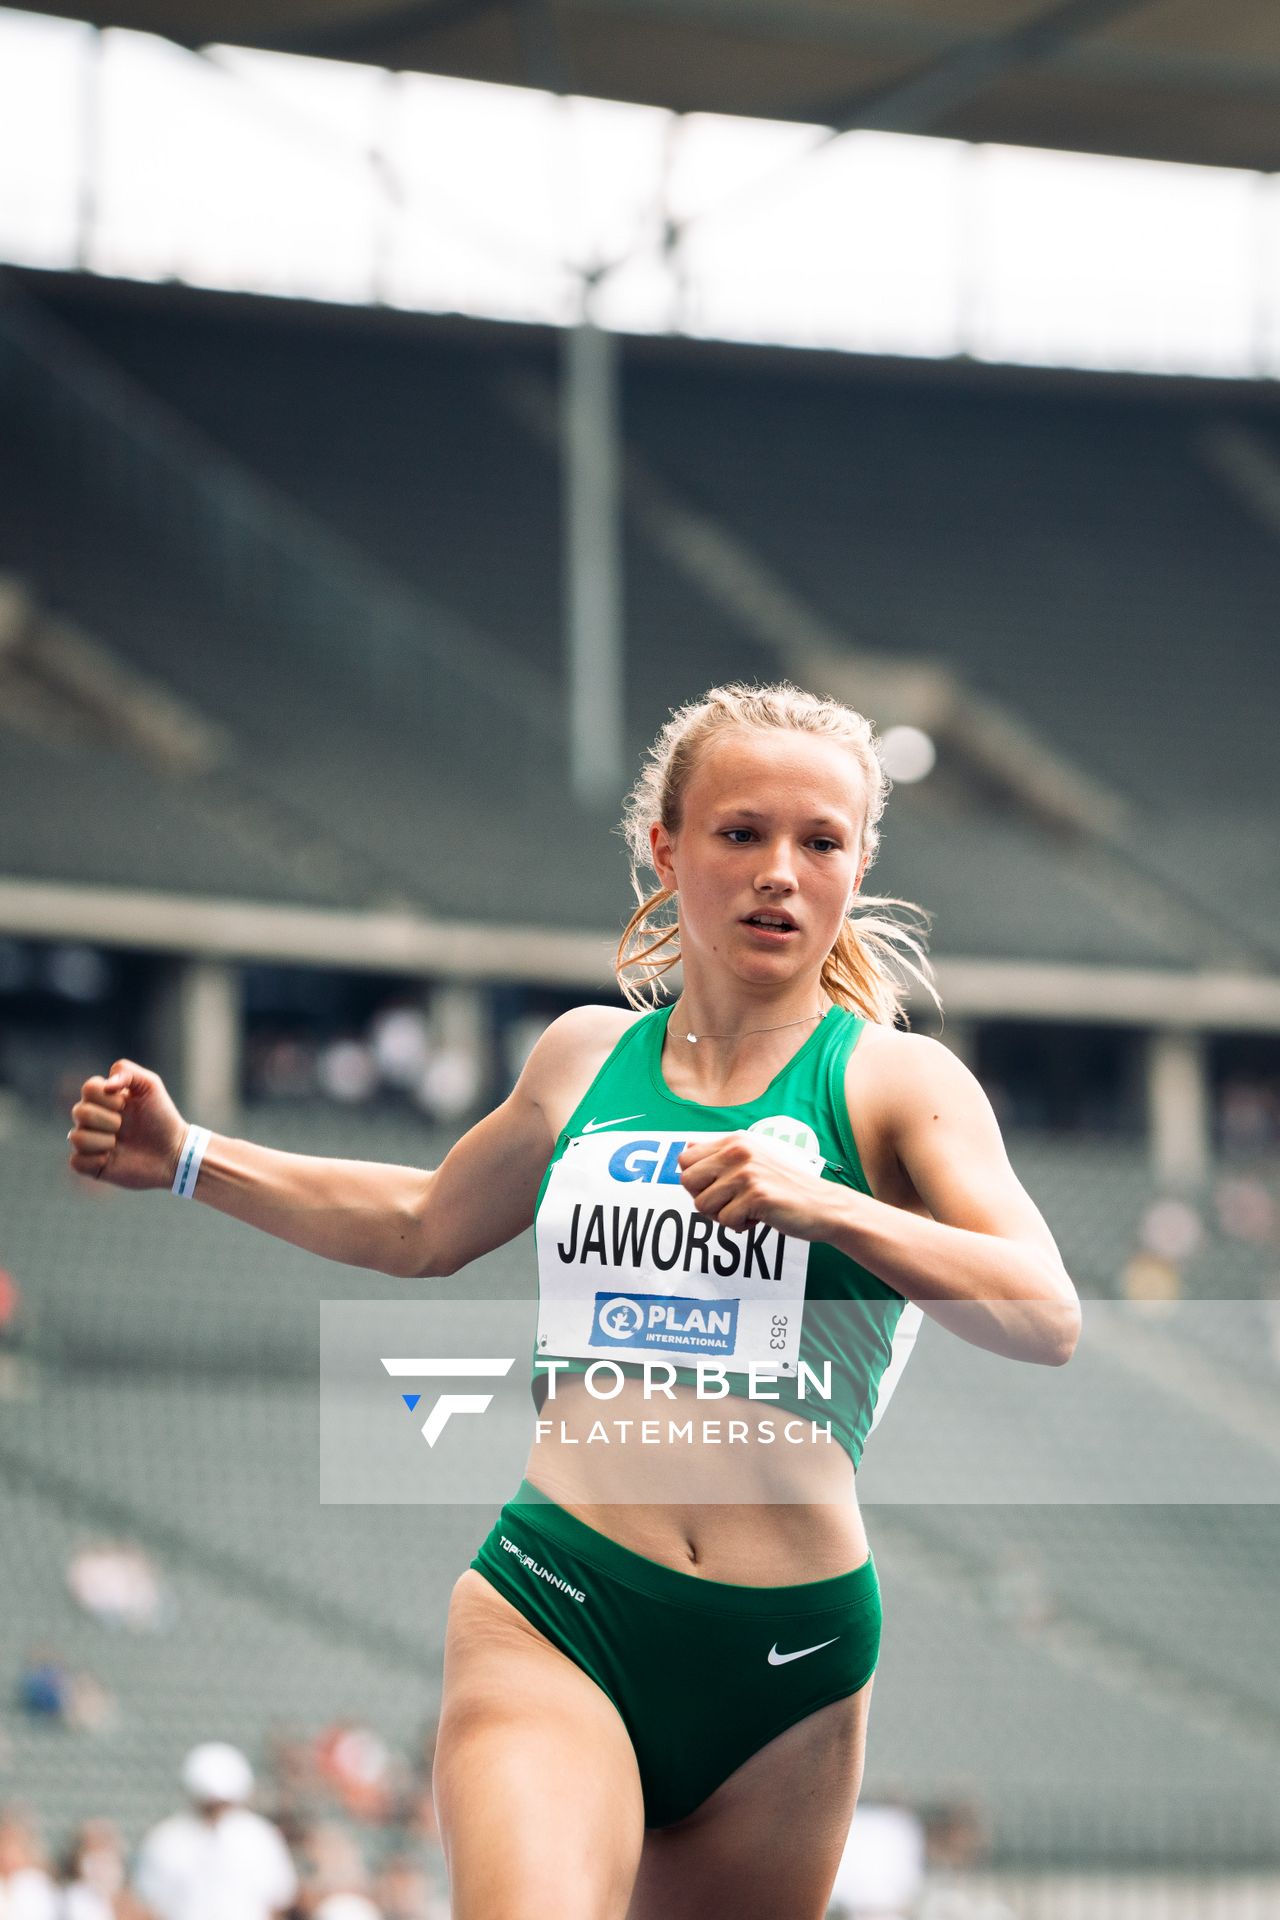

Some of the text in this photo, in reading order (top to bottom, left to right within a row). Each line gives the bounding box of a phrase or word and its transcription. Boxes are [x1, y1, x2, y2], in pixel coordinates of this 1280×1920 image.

[556, 1203, 787, 1282] JAWORSKI
[647, 1305, 731, 1335] PLAN
[769, 1314, 788, 1351] 353
[645, 1333, 729, 1349] INTERNATIONAL
